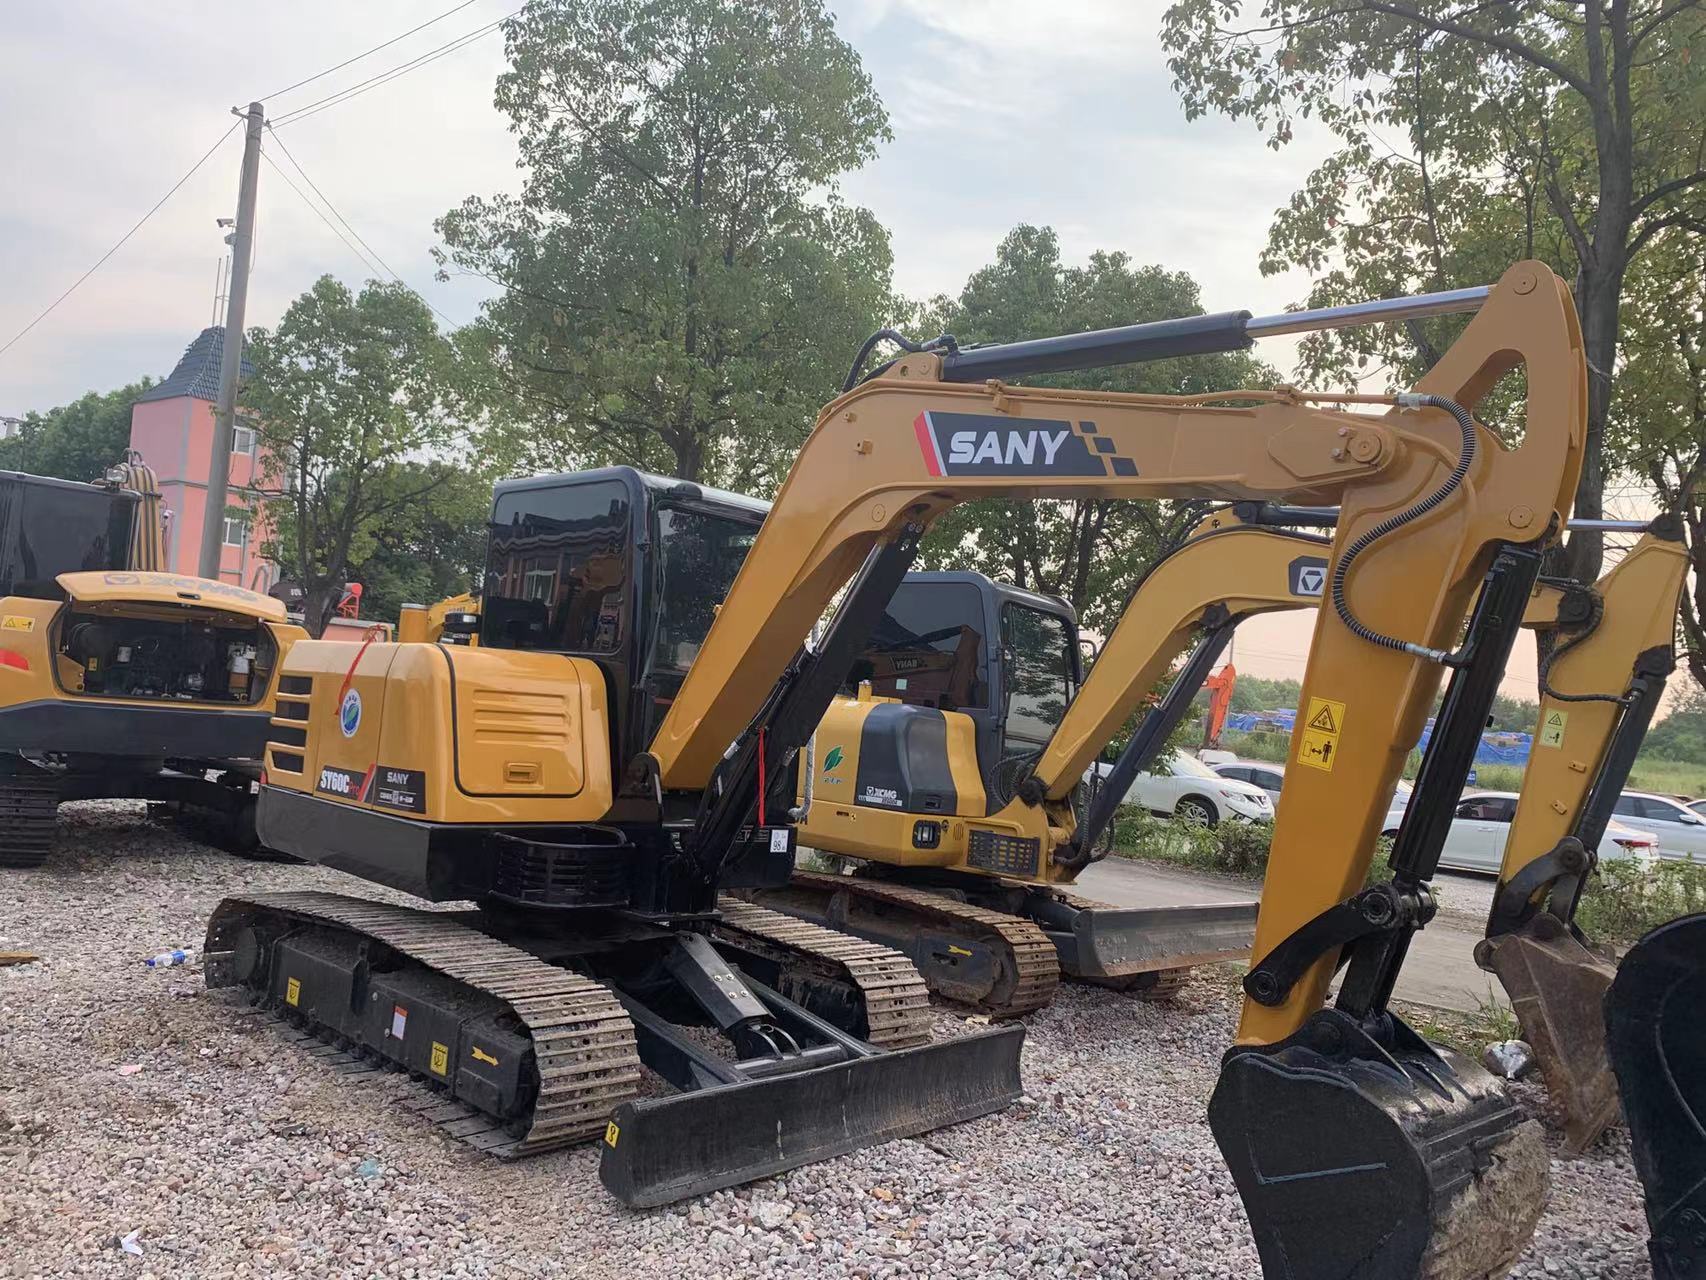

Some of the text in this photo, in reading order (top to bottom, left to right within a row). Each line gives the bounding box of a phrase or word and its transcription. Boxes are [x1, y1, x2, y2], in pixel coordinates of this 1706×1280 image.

[948, 430, 1070, 465] SANY
[320, 770, 350, 793] SY60C
[387, 772, 409, 784] SANY
[874, 787, 898, 800] XCMG
